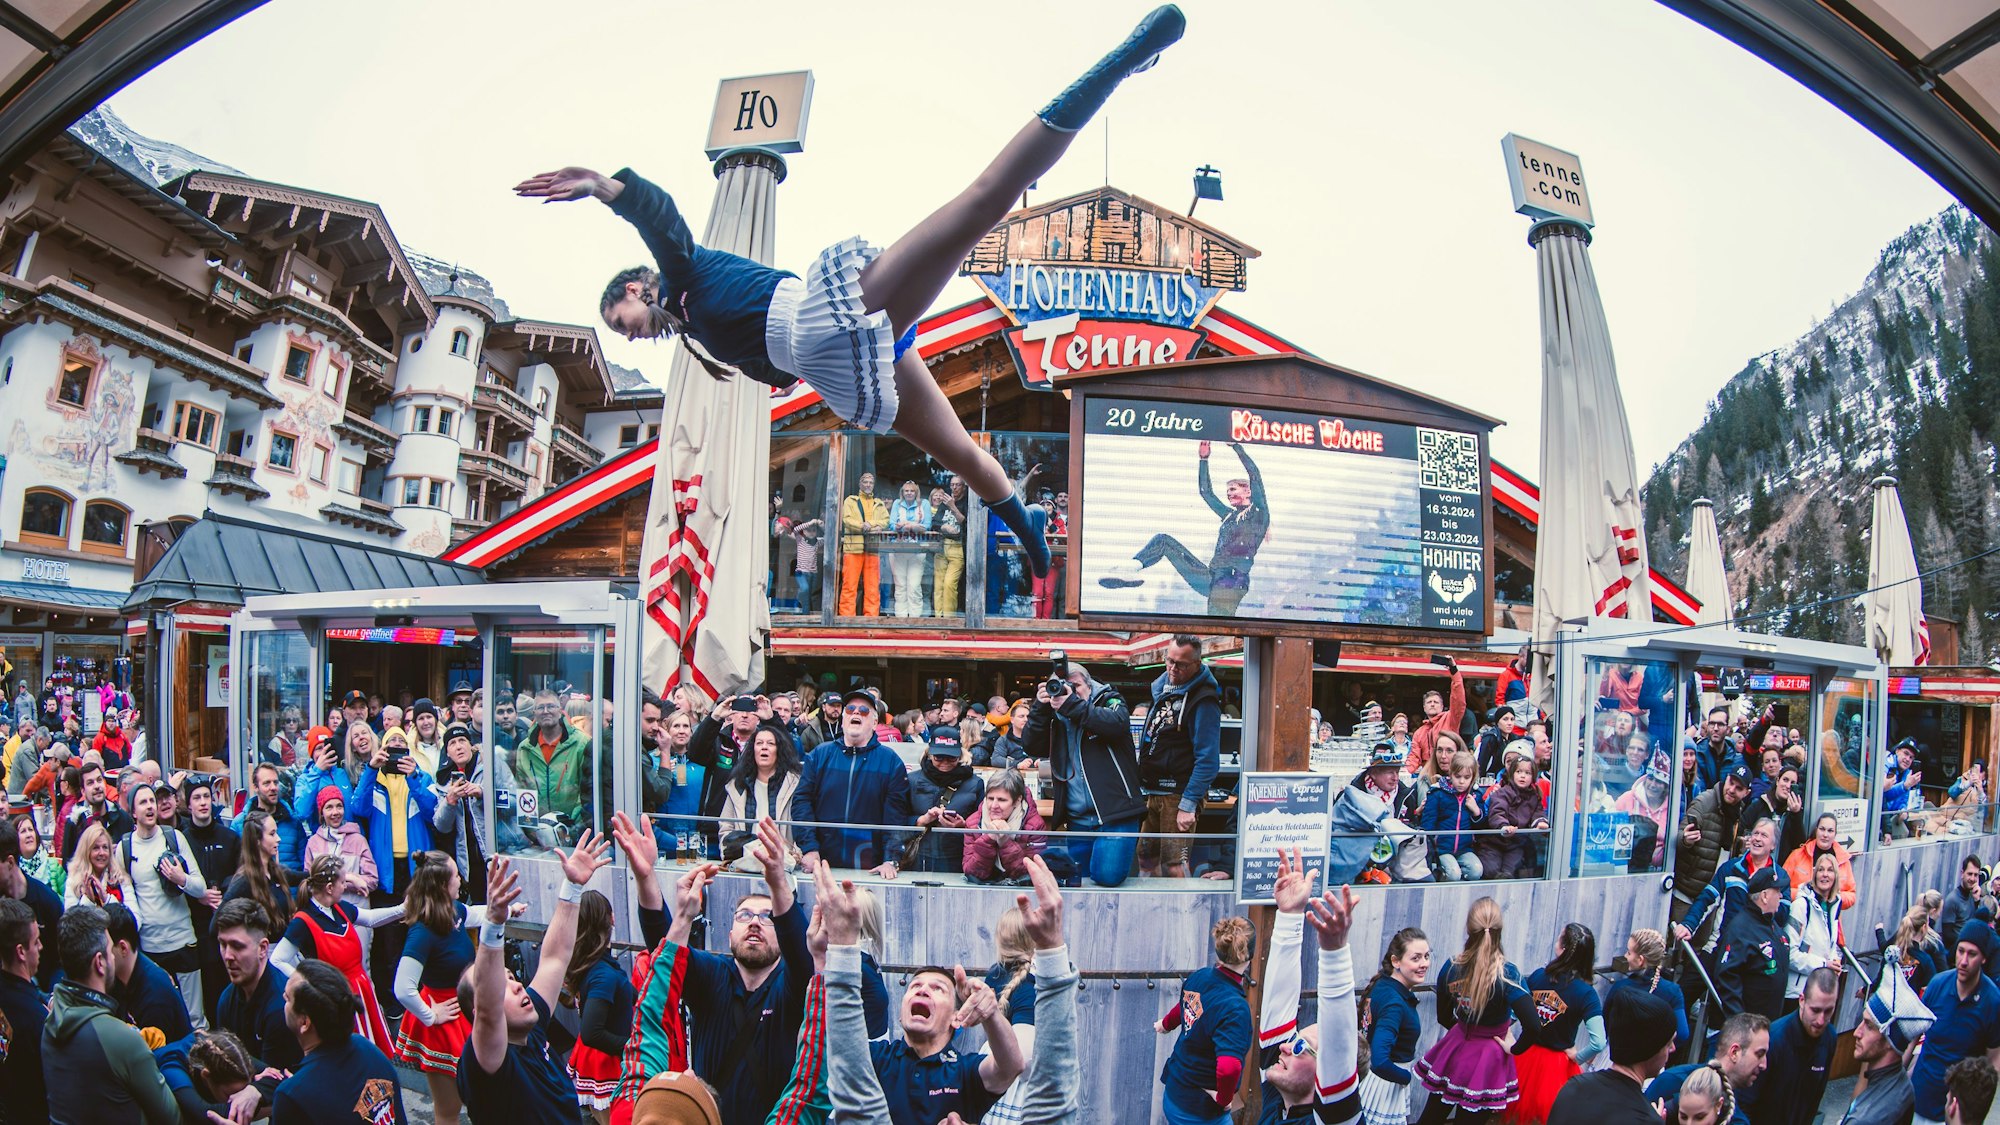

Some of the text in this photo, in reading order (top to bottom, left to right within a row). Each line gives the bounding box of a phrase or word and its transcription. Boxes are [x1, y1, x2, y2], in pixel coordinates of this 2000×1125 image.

[733, 90, 778, 131] HO
[1520, 151, 1580, 186] tenne
[1533, 181, 1580, 206] .com
[1008, 259, 1197, 318] HOHENHAUS
[1023, 312, 1177, 384] Tenne
[1105, 408, 1203, 433] 20 Jahre
[1439, 494, 1462, 504] vom
[1426, 505, 1475, 518] 16.3.2024
[1442, 518, 1458, 530] bis
[1424, 530, 1479, 545] 23.03.2024
[23, 558, 70, 581] HOTEL
[1423, 548, 1482, 571] HÖHNER
[1433, 606, 1473, 616] und viele
[1248, 783, 1323, 802] HOHENHAUS Express
[1285, 823, 1324, 831] Hotelshuttle
[1260, 833, 1309, 843] für Hotelgäste
